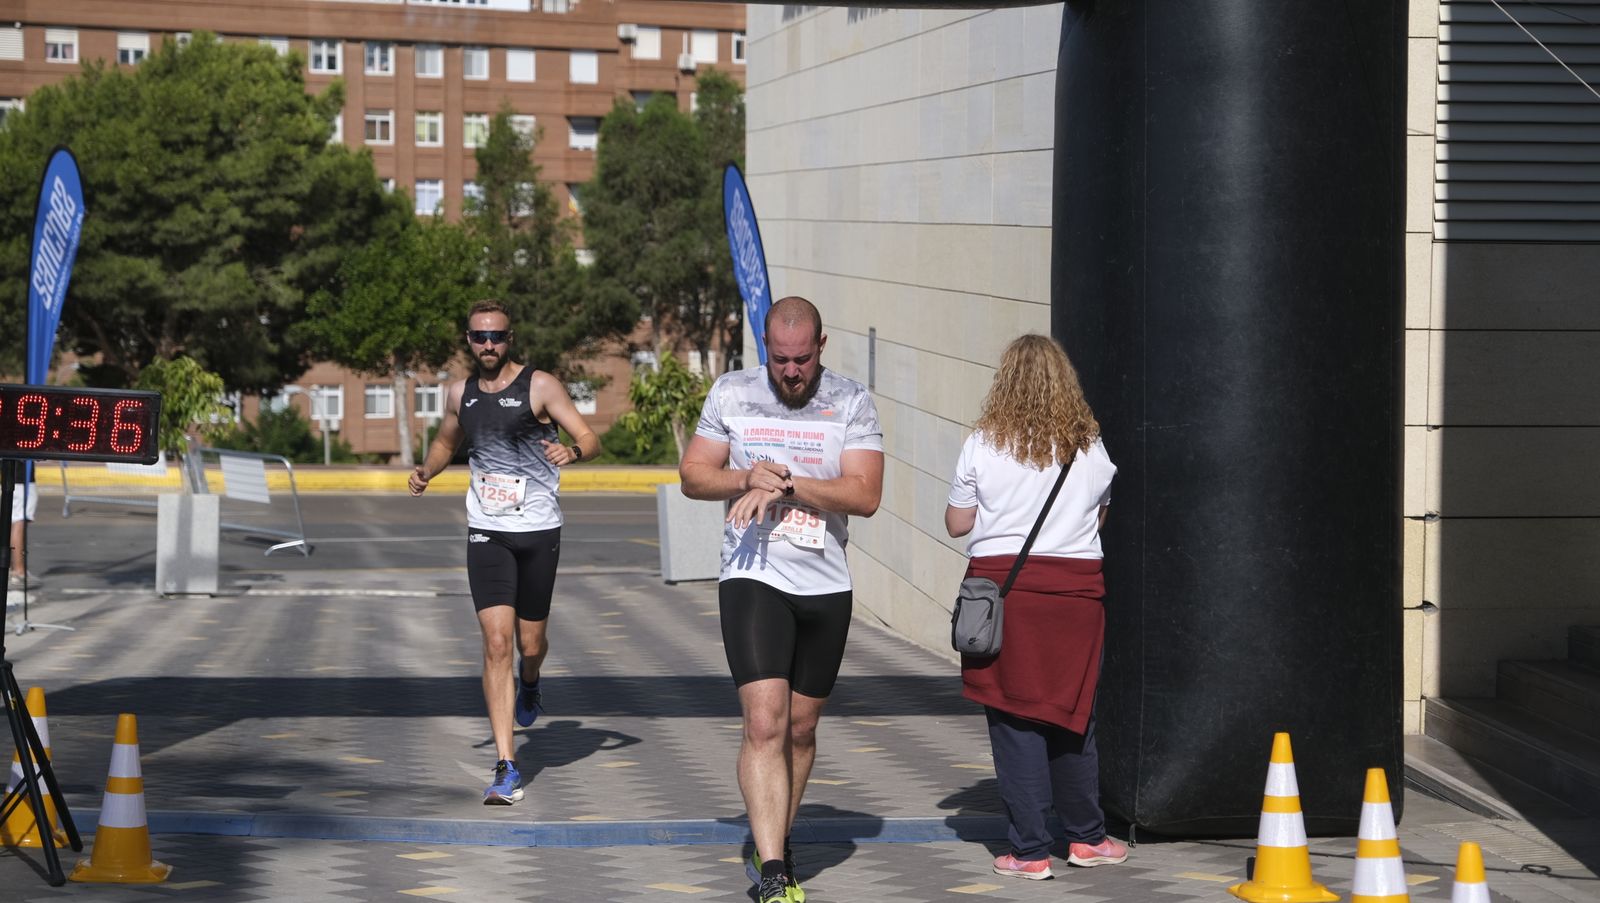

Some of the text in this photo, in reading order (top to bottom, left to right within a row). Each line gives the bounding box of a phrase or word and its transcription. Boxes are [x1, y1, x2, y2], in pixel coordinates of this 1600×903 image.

[0, 394, 143, 453] 9:36
[750, 428, 785, 438] CARRERA
[786, 430, 800, 440] SIN
[802, 431, 825, 441] HUMO
[479, 485, 519, 504] 1254
[767, 504, 820, 529] 1095
